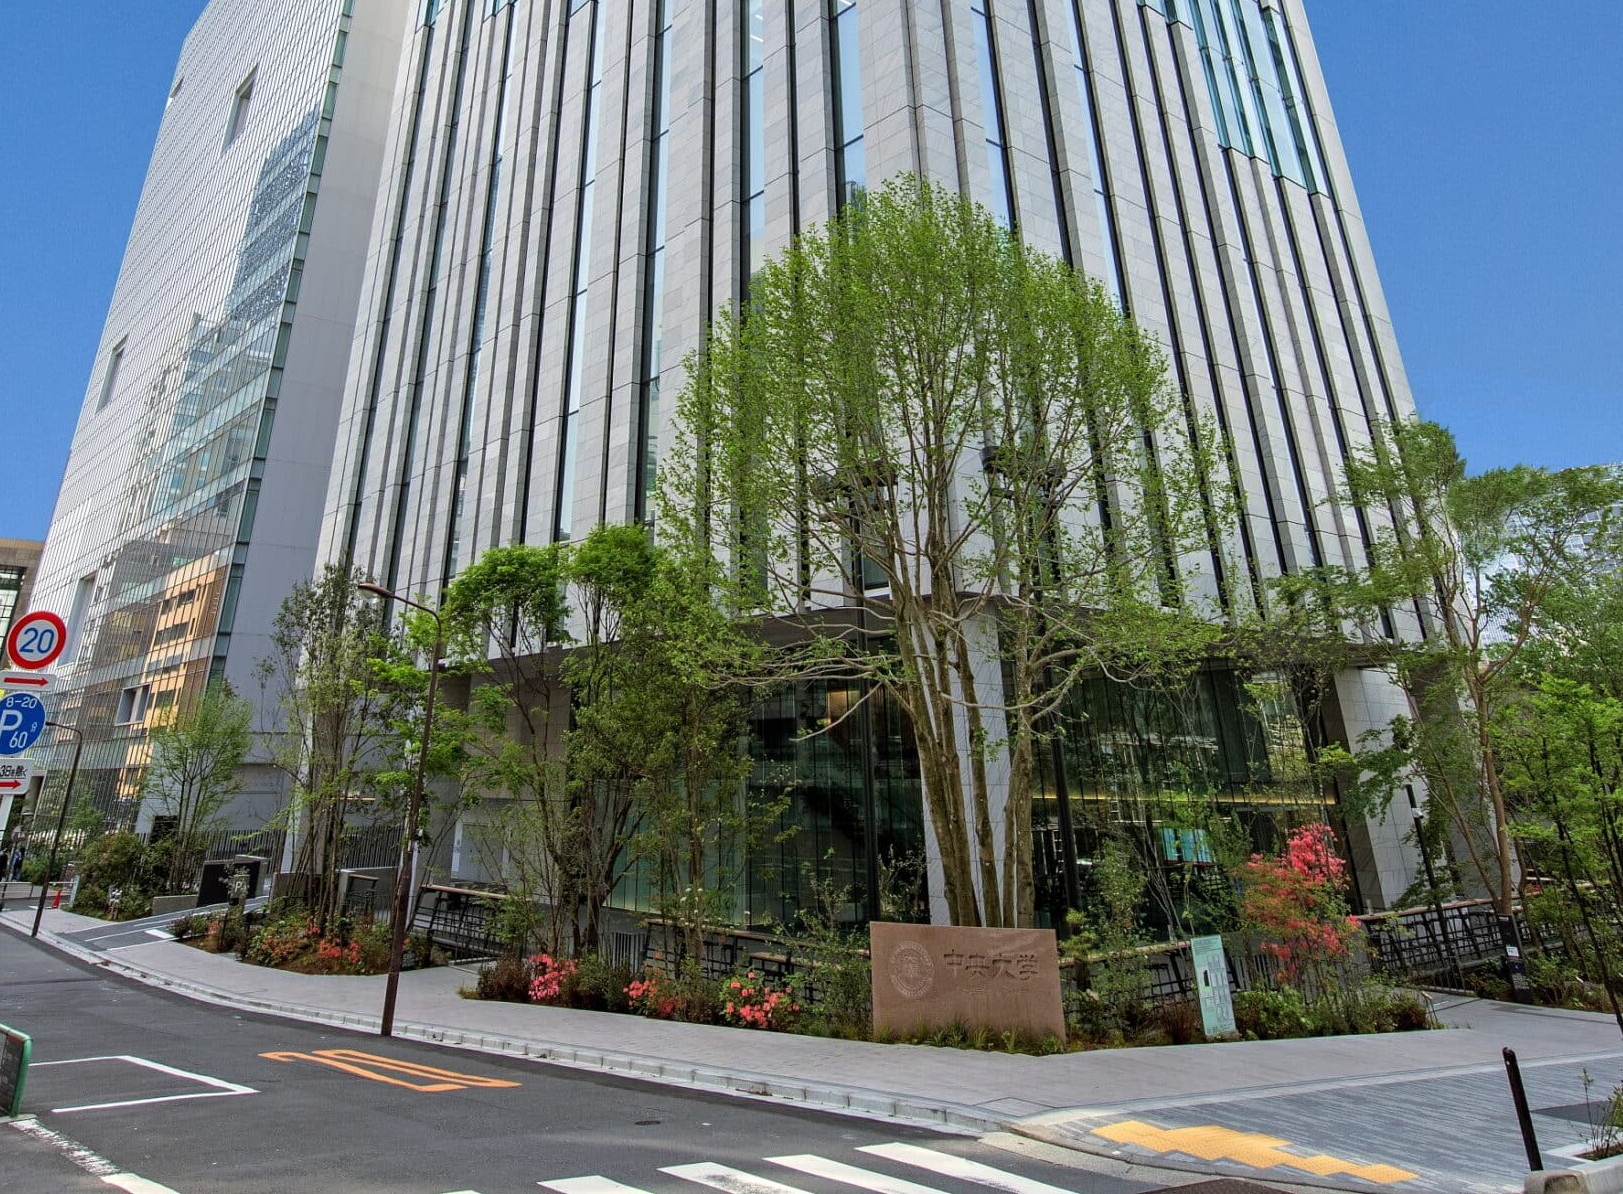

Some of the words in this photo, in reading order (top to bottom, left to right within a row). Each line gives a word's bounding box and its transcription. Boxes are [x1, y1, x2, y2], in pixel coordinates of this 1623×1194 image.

[19, 627, 55, 654] 20
[6, 696, 38, 709] 8-20
[0, 709, 23, 739] P
[9, 731, 28, 749] 60
[943, 948, 1039, 981] 中央大学
